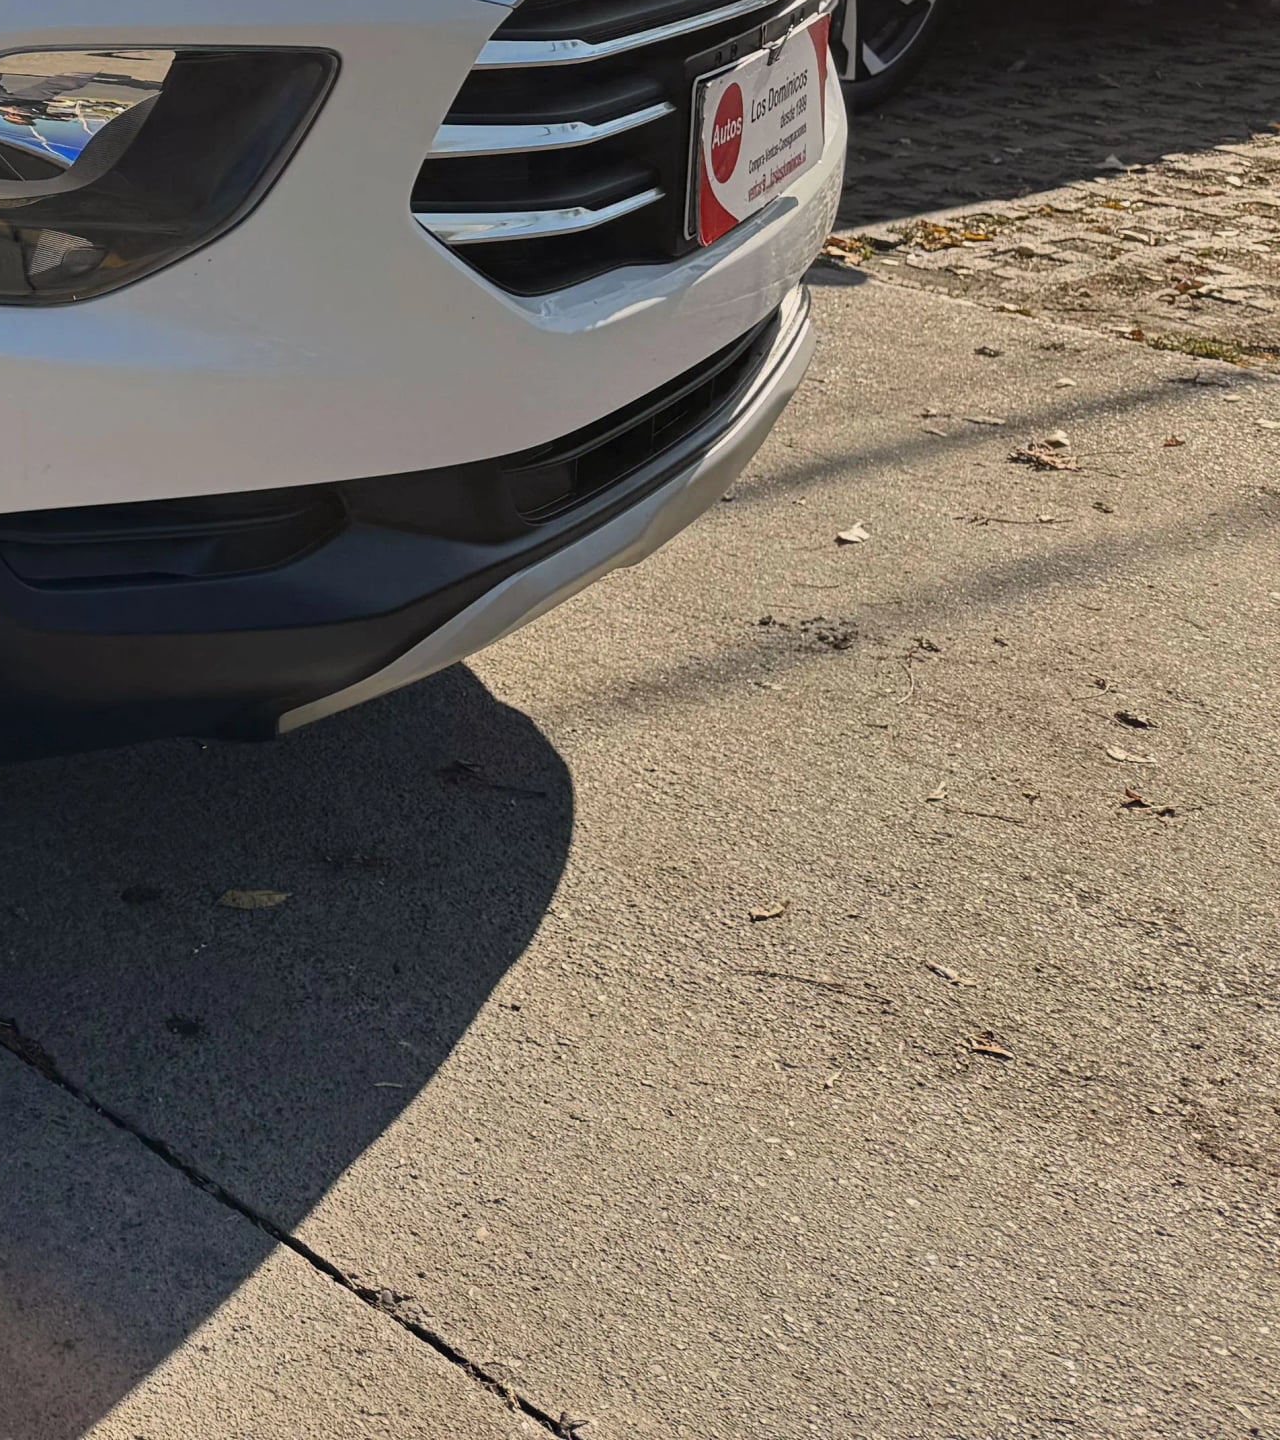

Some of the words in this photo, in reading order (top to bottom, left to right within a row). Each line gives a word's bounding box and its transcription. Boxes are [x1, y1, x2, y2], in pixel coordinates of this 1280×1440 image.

[750, 98, 766, 124] Los
[768, 68, 809, 112] Dominicos
[711, 116, 743, 150] Autos
